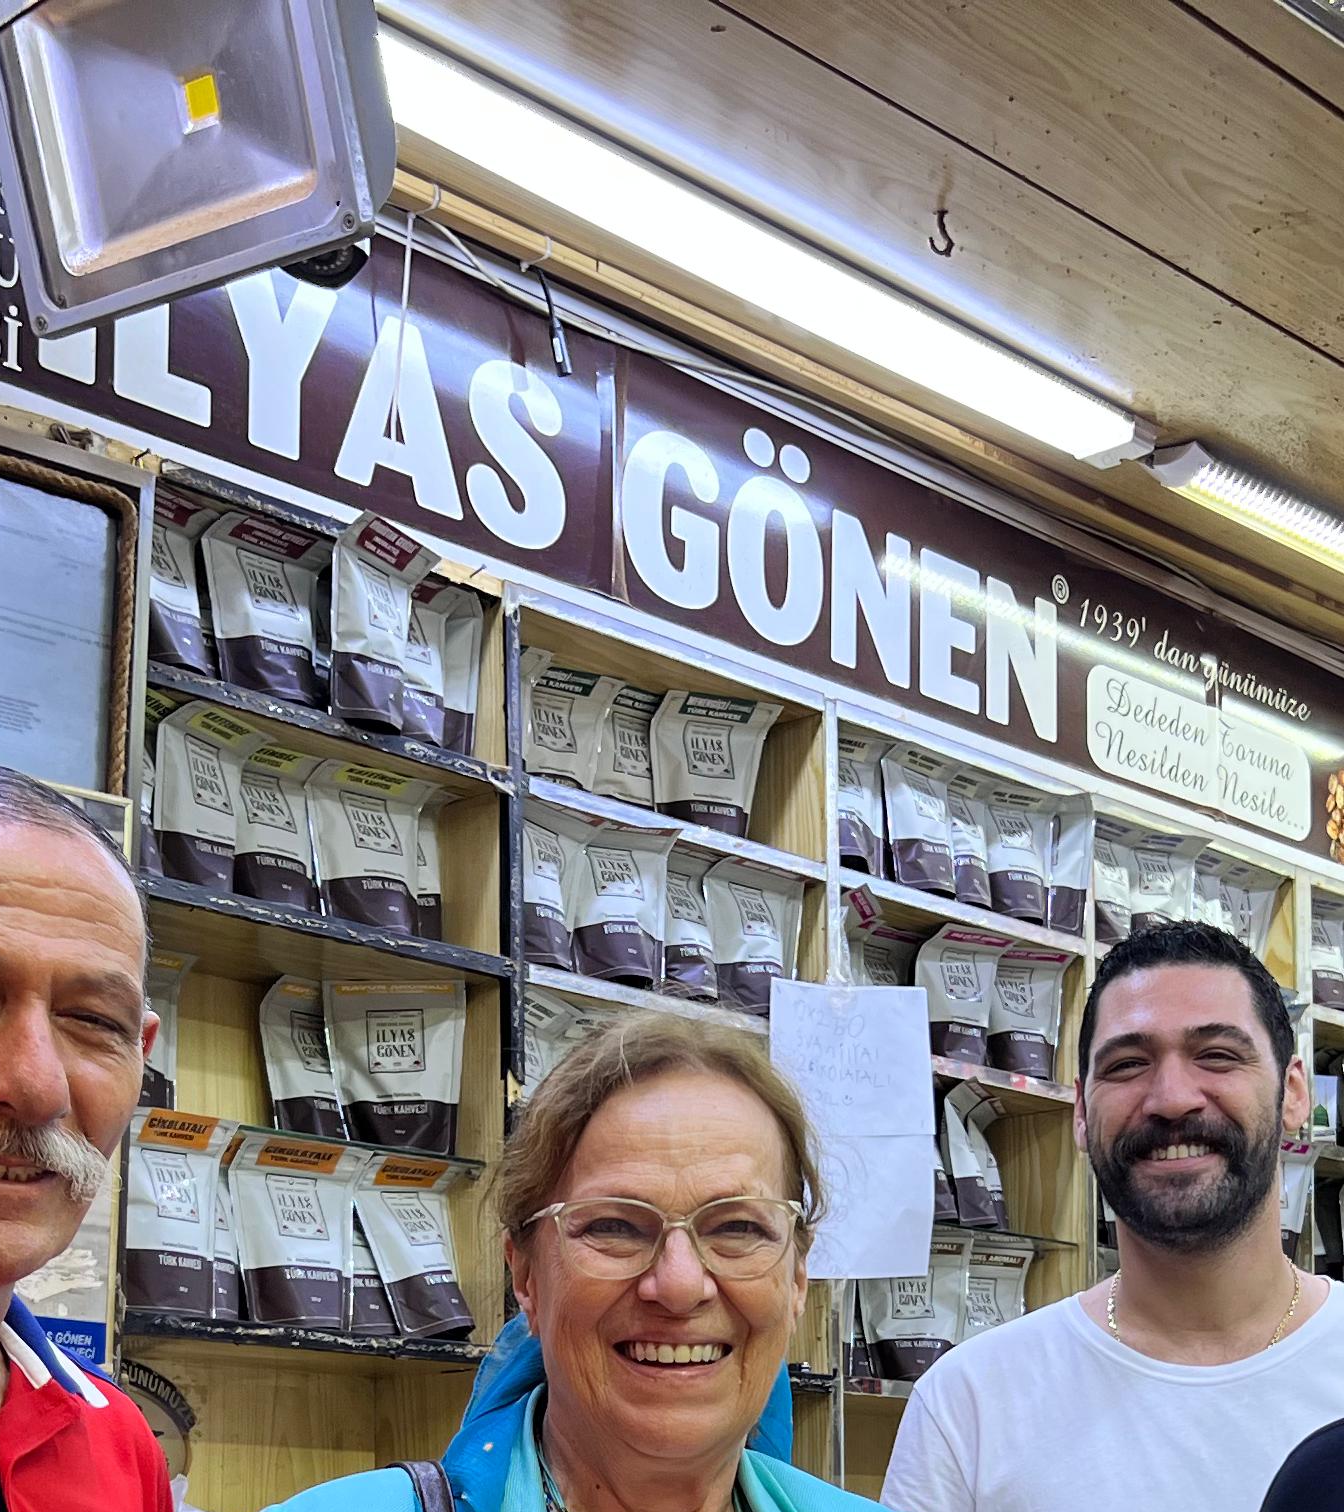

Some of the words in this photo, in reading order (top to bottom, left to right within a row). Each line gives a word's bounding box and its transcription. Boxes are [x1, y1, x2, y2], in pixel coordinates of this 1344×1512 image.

[623, 428, 1058, 742] GÖNEN
[1154, 629, 1199, 672] dan
[1106, 677, 1210, 746] Dededen
[1095, 720, 1209, 792] Nesilden
[56, 1331, 92, 1345] GÖNEN
